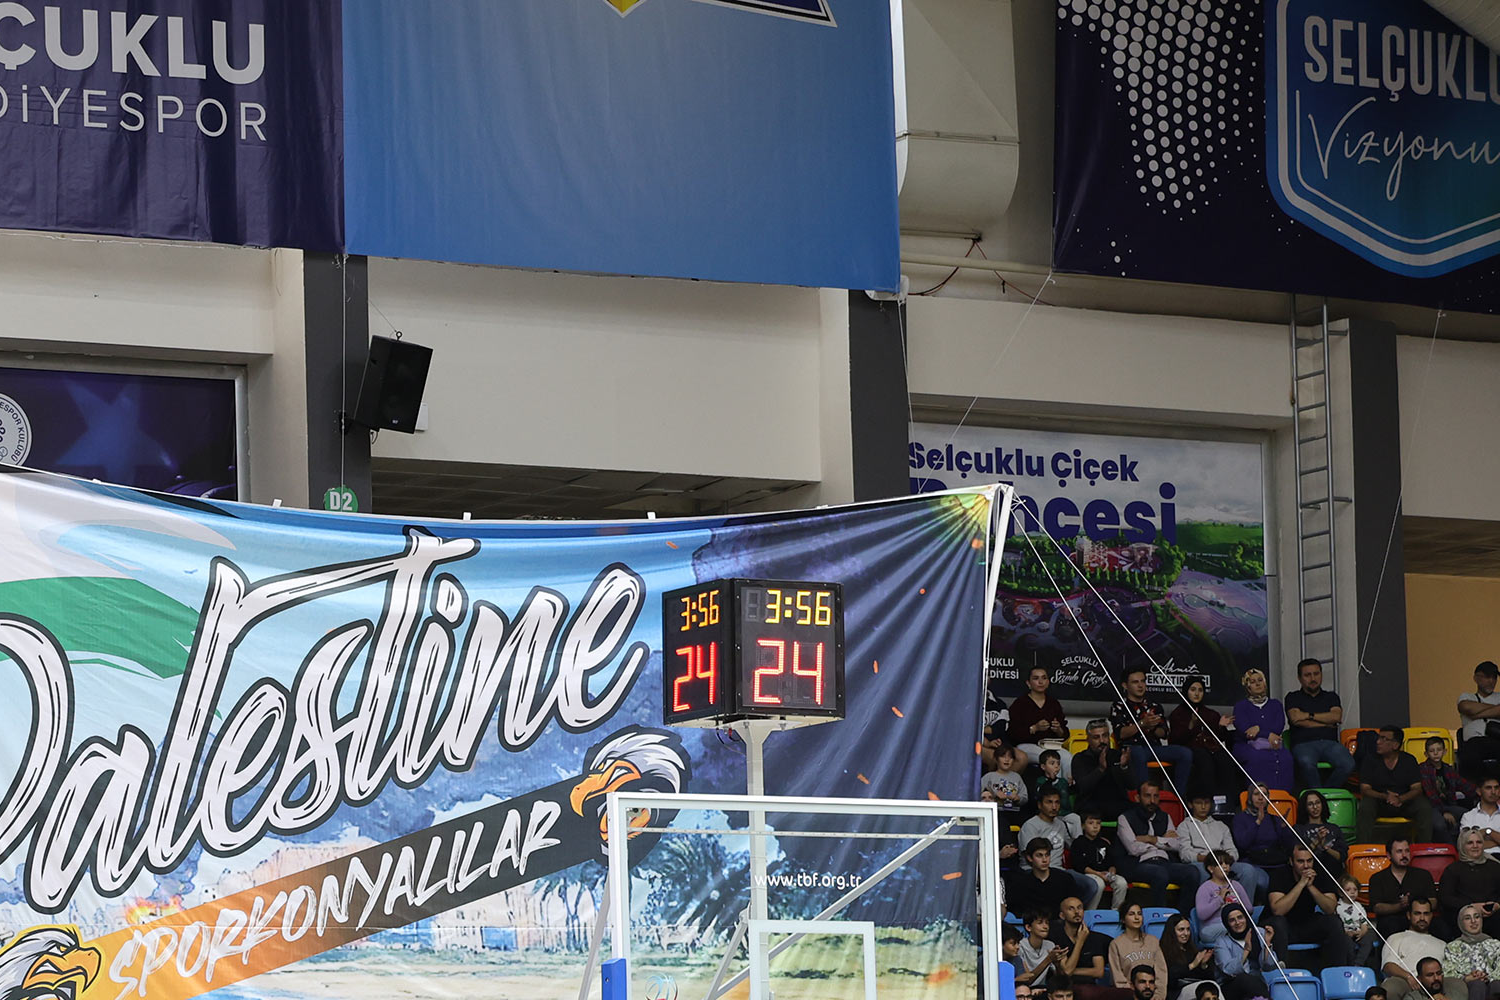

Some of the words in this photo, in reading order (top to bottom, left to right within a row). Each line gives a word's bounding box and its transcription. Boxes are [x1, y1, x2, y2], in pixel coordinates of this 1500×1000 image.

[908, 441, 1045, 479] Selçuklu
[1051, 449, 1140, 488] Çiçek
[329, 491, 353, 511] D2
[680, 589, 720, 632] 3:56
[765, 589, 832, 626] 3:56
[673, 641, 717, 712] 24
[753, 640, 825, 706] 24
[989, 668, 1019, 680] DİYESİ
[754, 872, 862, 890] www.tbf.org.tr
